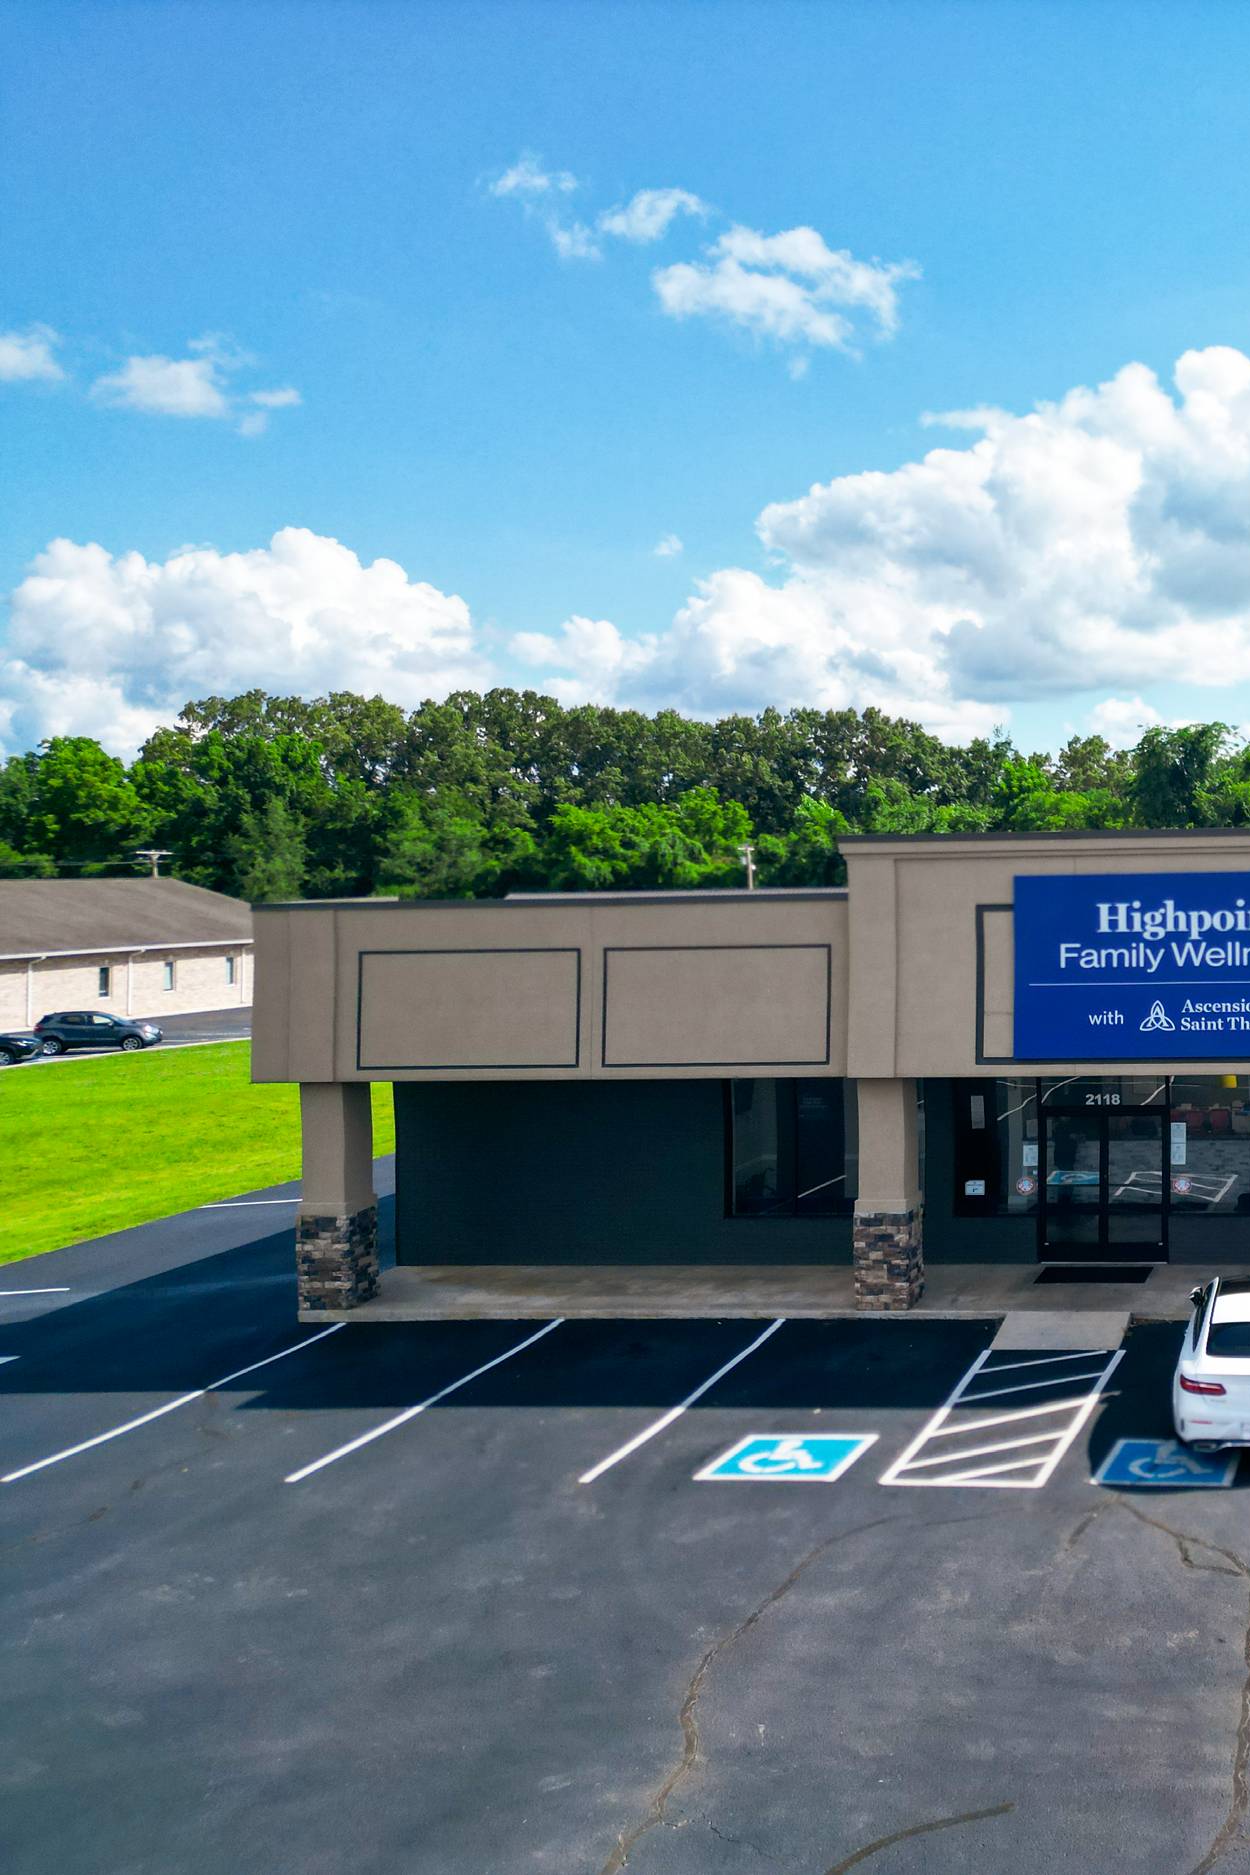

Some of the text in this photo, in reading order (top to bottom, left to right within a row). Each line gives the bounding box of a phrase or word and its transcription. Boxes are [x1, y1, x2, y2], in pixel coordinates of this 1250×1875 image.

[1059, 942, 1165, 973] Family
[1088, 1009, 1124, 1026] with
[1180, 1017, 1224, 1032] Saint
[1085, 1093, 1121, 1105] 2118
